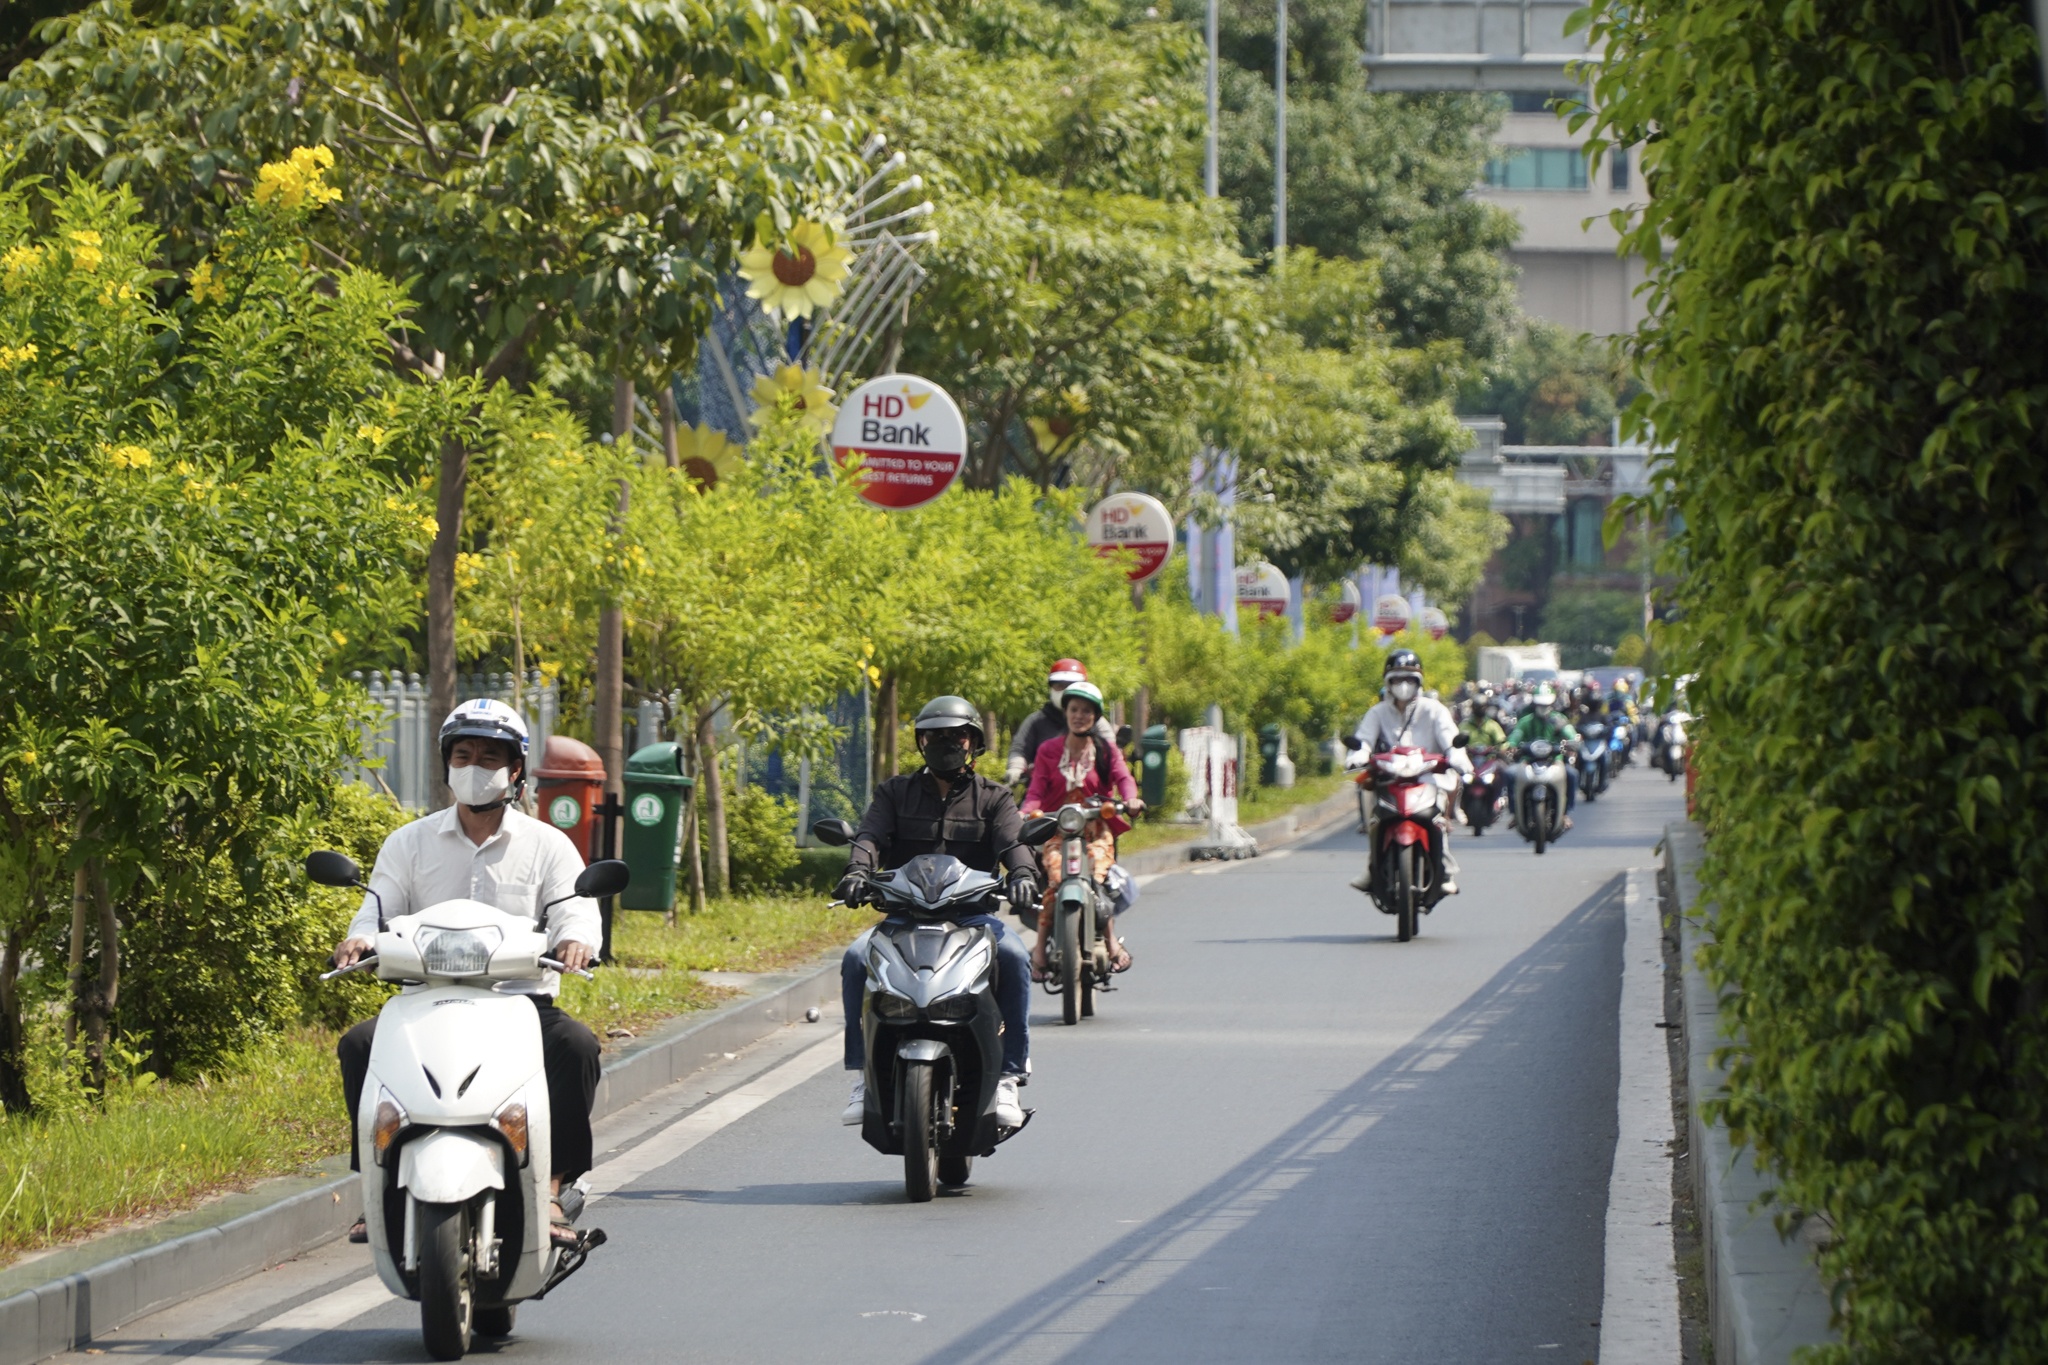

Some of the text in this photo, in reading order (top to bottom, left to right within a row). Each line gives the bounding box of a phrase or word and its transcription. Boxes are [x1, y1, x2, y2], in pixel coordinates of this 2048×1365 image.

[863, 394, 904, 419] HD
[862, 419, 931, 447] Bank
[907, 459, 922, 471] TO
[924, 460, 955, 473] YOUR
[886, 472, 934, 486] RETURNS
[1101, 507, 1129, 525] HD
[1103, 523, 1149, 540] Bank
